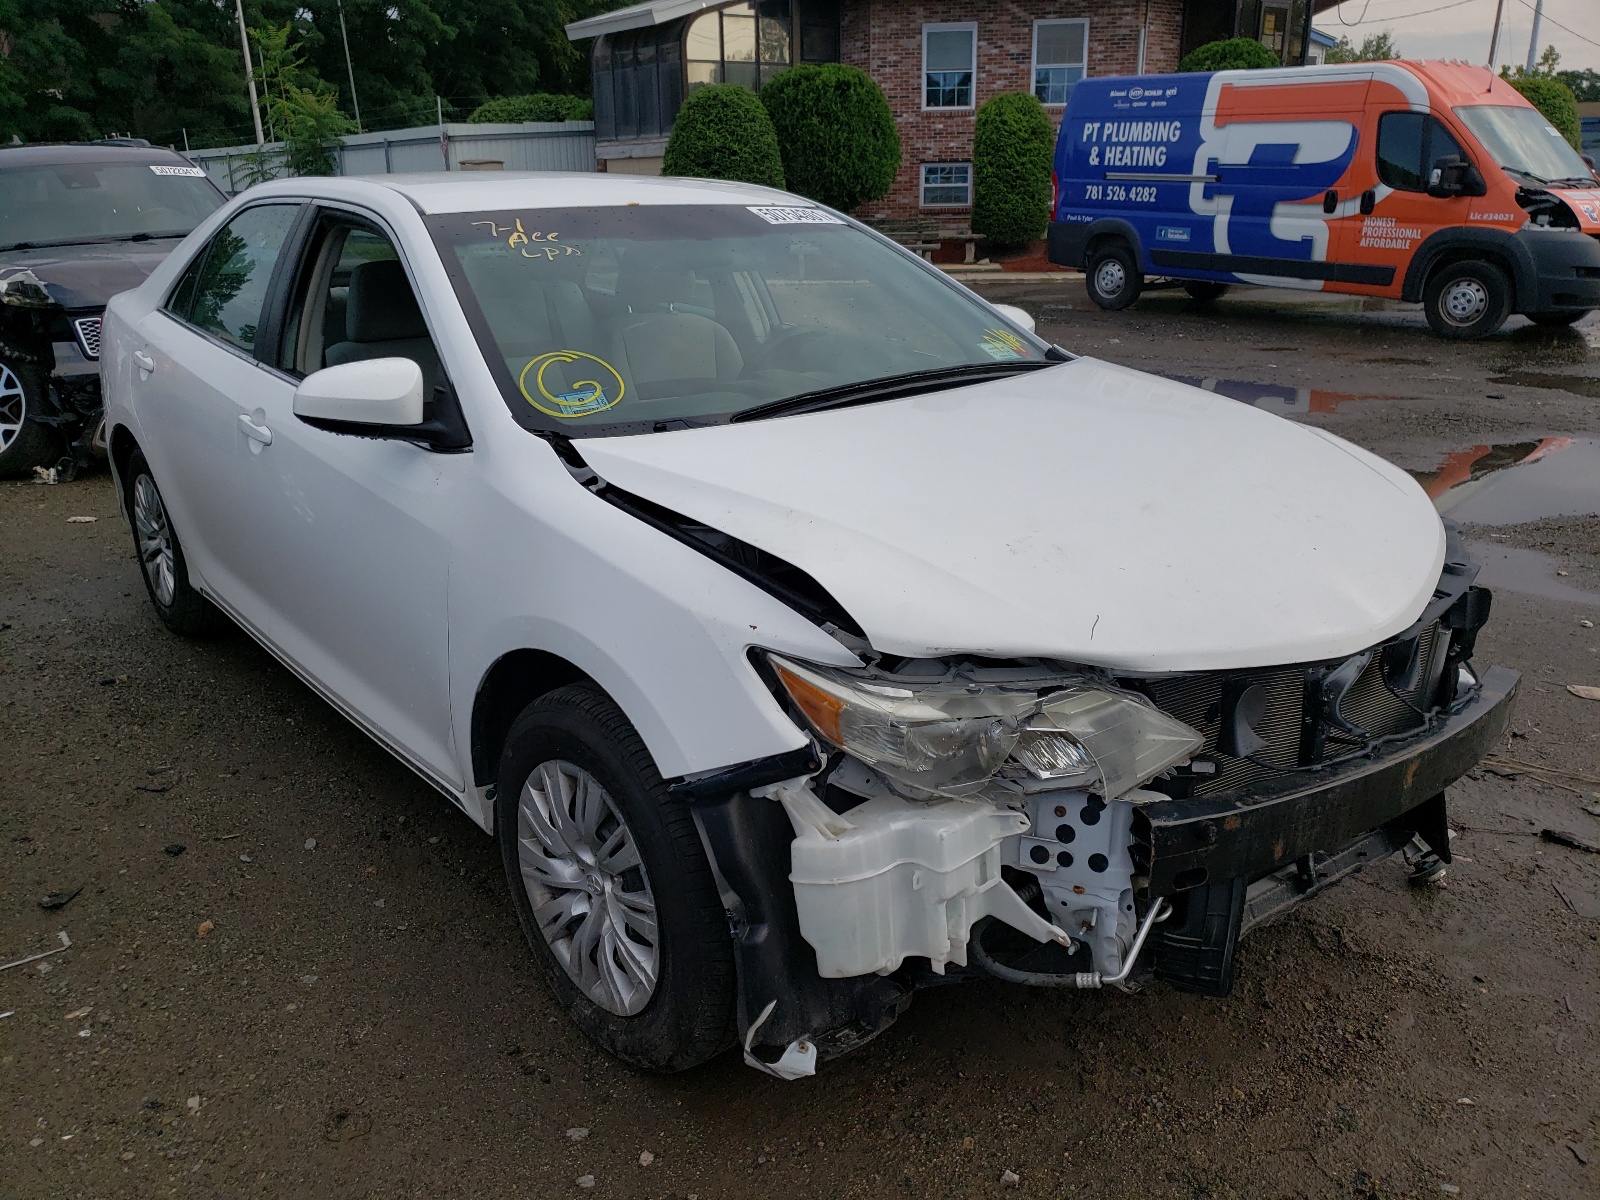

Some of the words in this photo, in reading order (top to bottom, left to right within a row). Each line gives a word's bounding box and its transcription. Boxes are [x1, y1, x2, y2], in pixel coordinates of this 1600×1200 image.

[1082, 122, 1101, 143] PT
[1103, 122, 1181, 142] PLUMBING
[1089, 146, 1100, 166] &
[1104, 146, 1167, 167] HEATING
[1085, 185, 1157, 202] 781.526.4282
[1364, 216, 1397, 228] HONEST
[1362, 226, 1422, 240] PROFESSIONAL
[1360, 237, 1411, 250] AFFORDABLE
